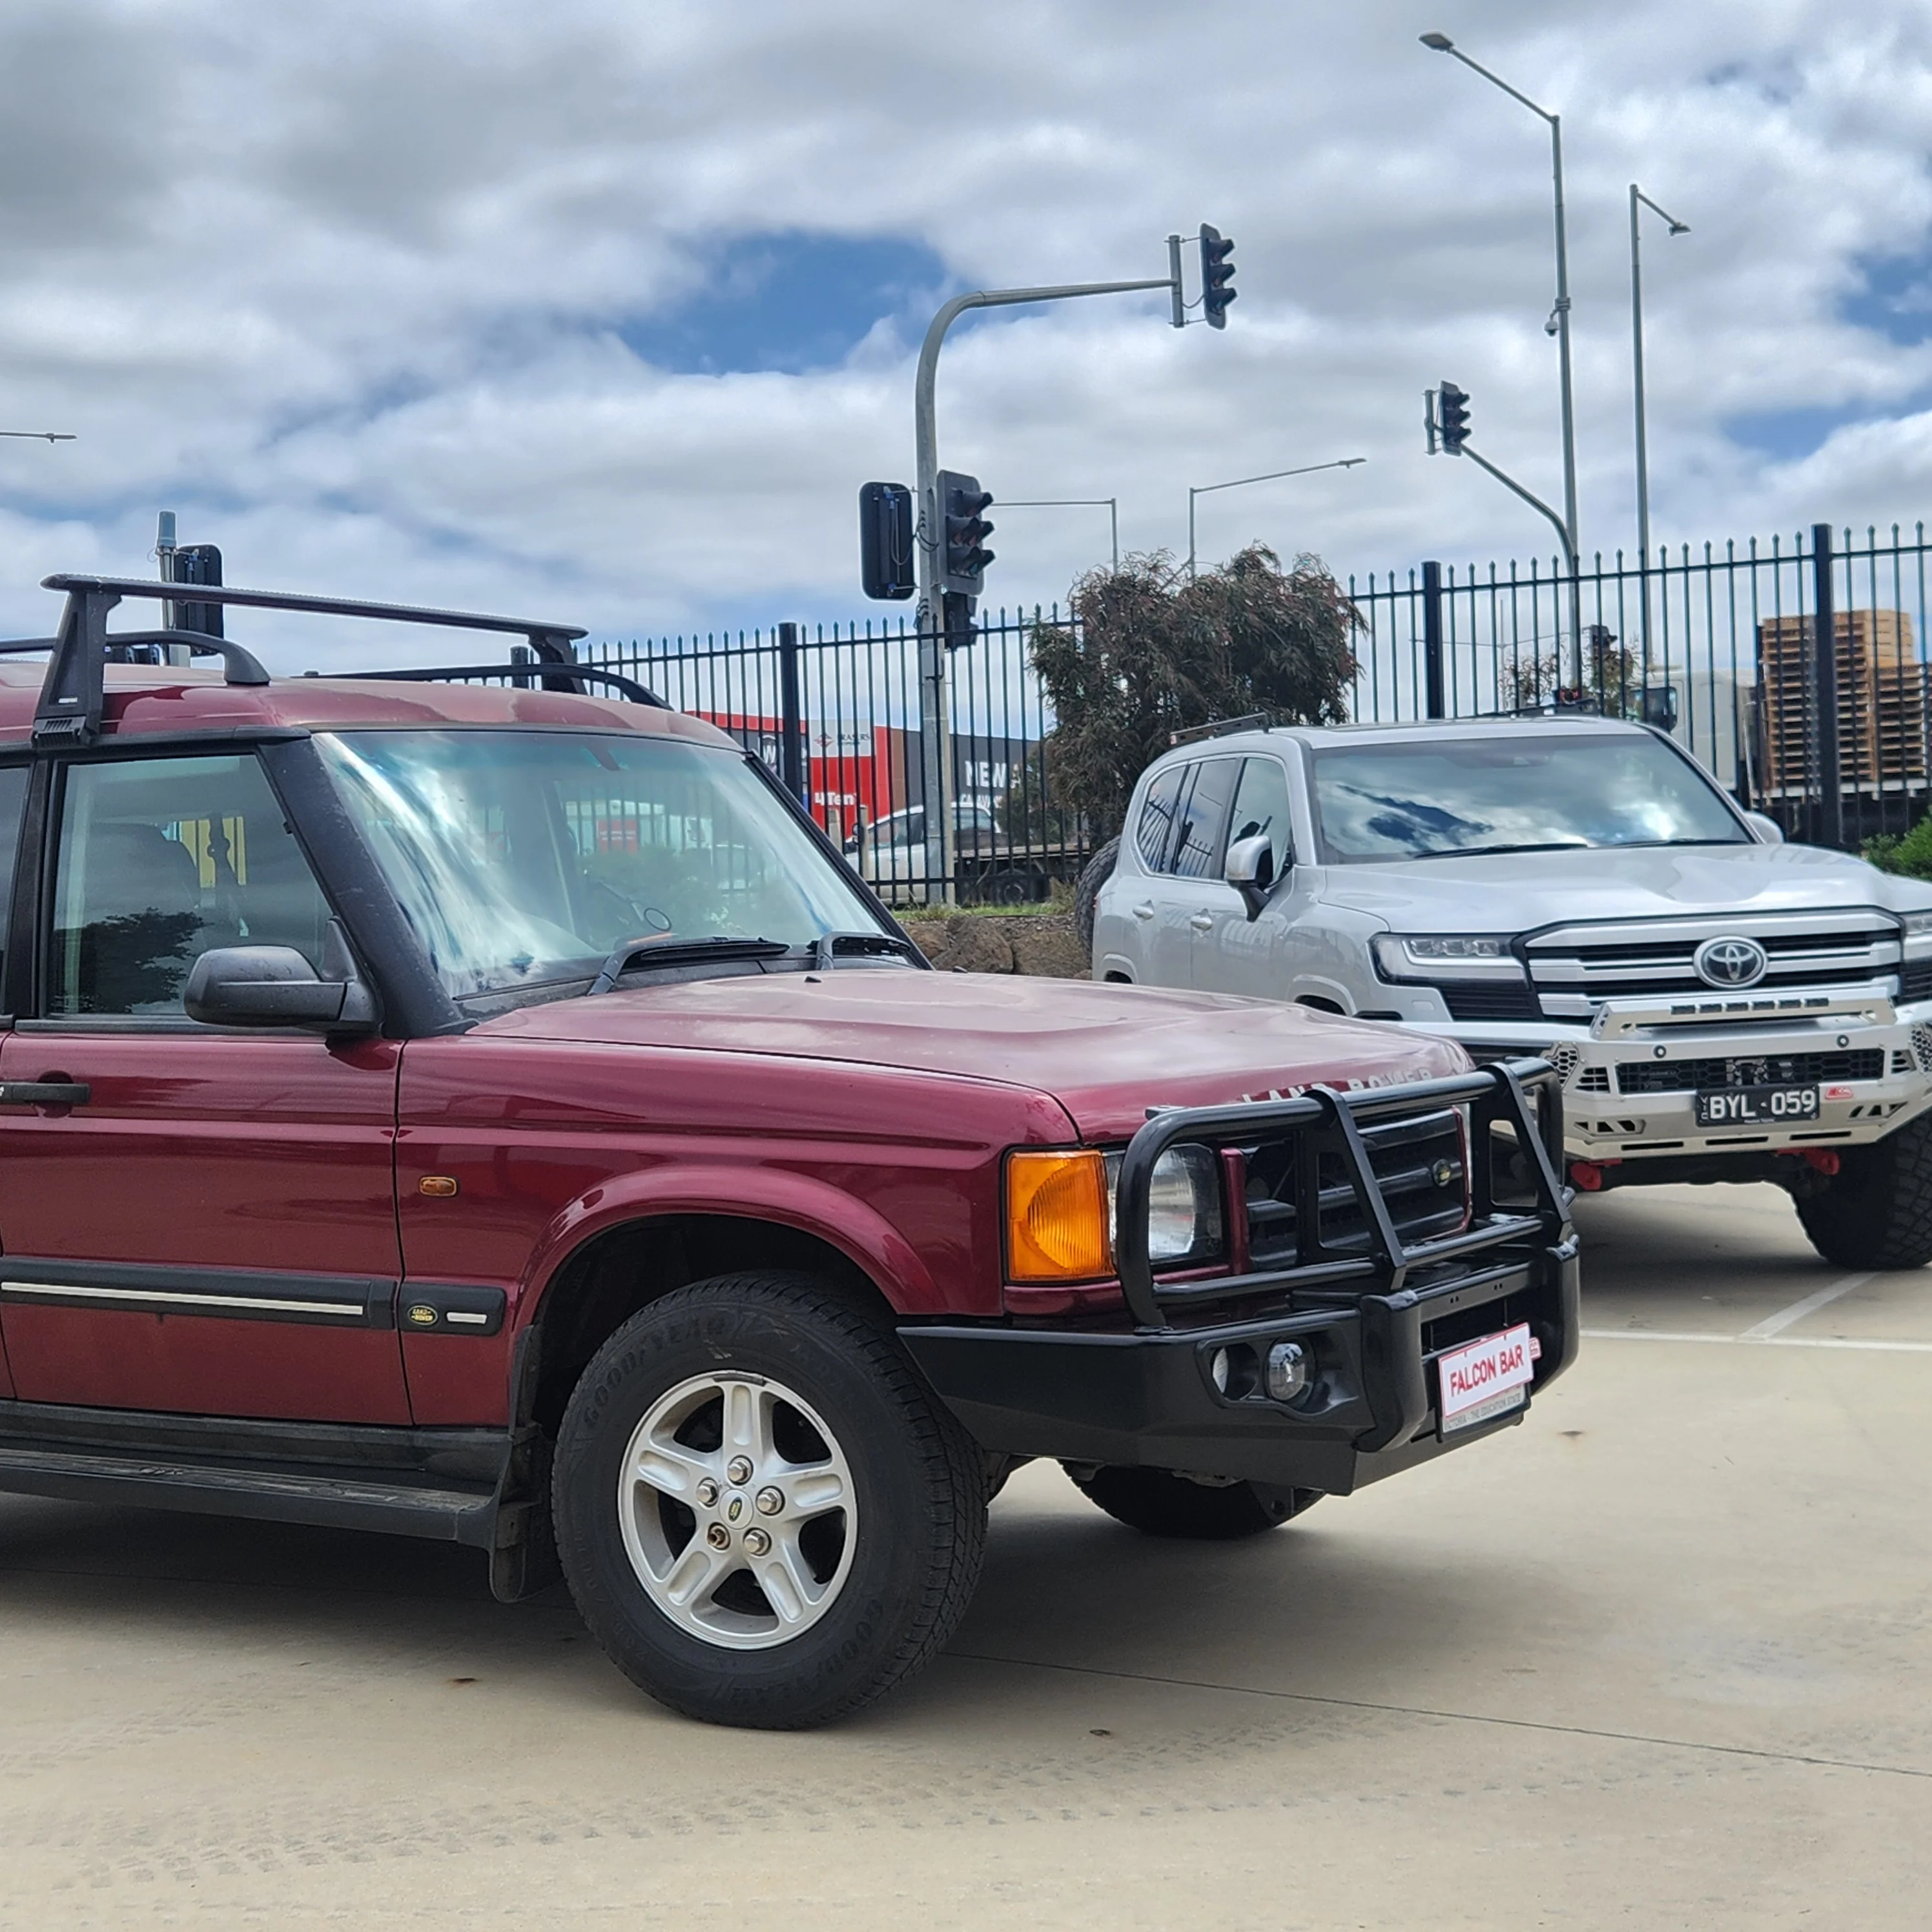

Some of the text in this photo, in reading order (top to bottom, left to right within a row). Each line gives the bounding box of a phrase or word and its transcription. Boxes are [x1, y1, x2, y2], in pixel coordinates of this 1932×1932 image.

[1709, 1094, 1756, 1119] BYL
[1771, 1090, 1816, 1115] 059
[1450, 1355, 1497, 1397] FALCON
[1499, 1344, 1524, 1375] BAR
